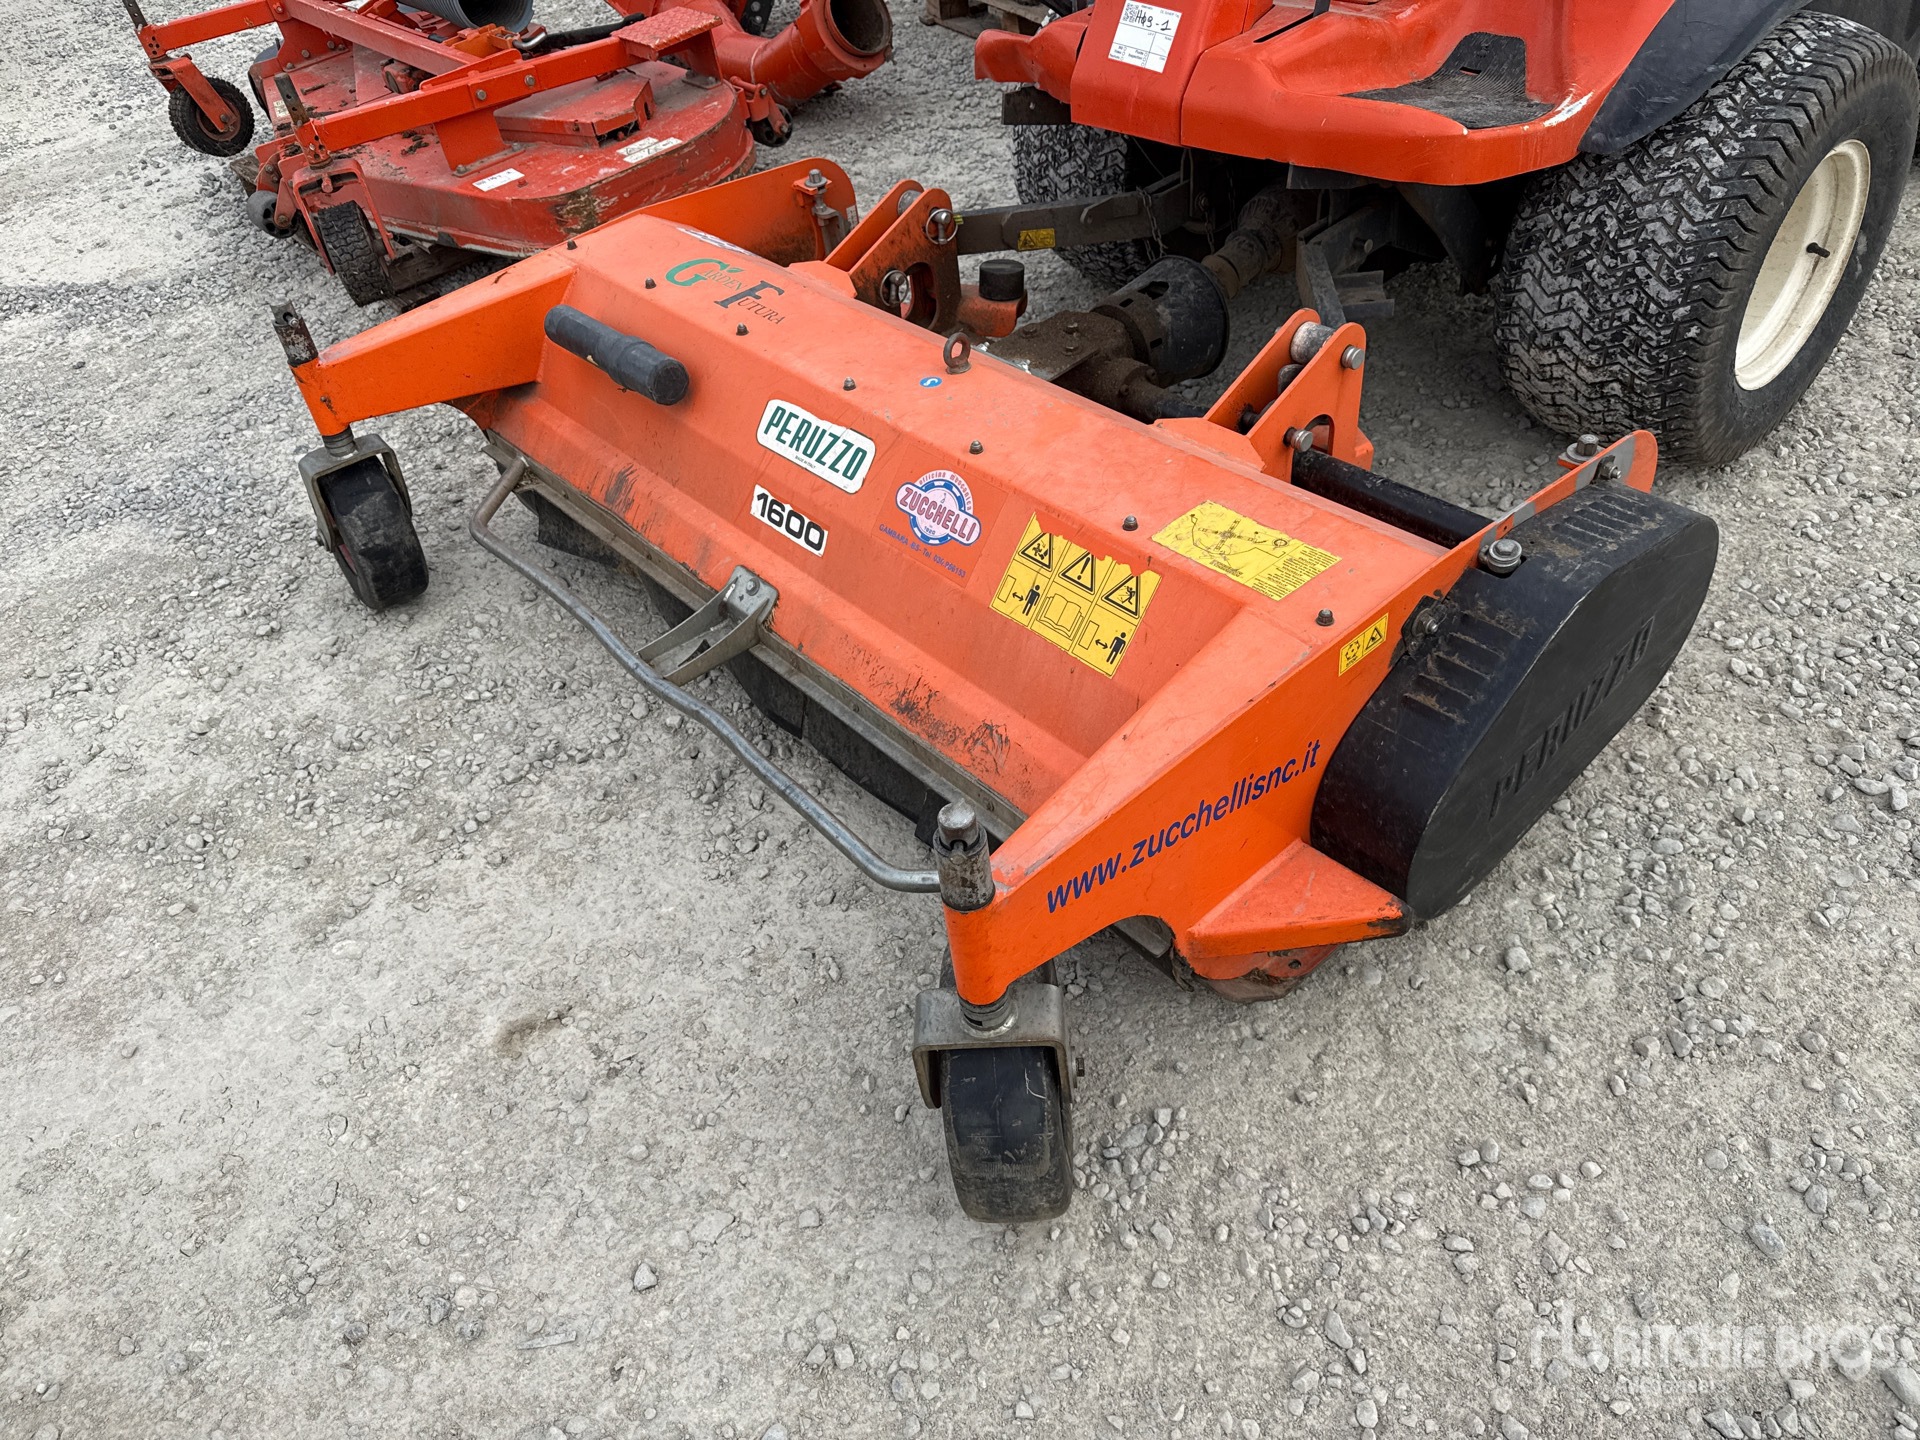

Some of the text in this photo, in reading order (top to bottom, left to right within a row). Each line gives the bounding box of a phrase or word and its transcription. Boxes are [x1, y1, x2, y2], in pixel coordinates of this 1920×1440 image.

[665, 258, 787, 325] GARDEN FUTURA
[763, 405, 868, 481] PERUZZO
[756, 492, 825, 552] 1600
[879, 523, 909, 545] GAMBARA
[899, 486, 977, 542] ZUCCHELLI
[1488, 614, 1656, 822] PERUZZO
[1047, 739, 1321, 914] www.zucchellisnc.it
